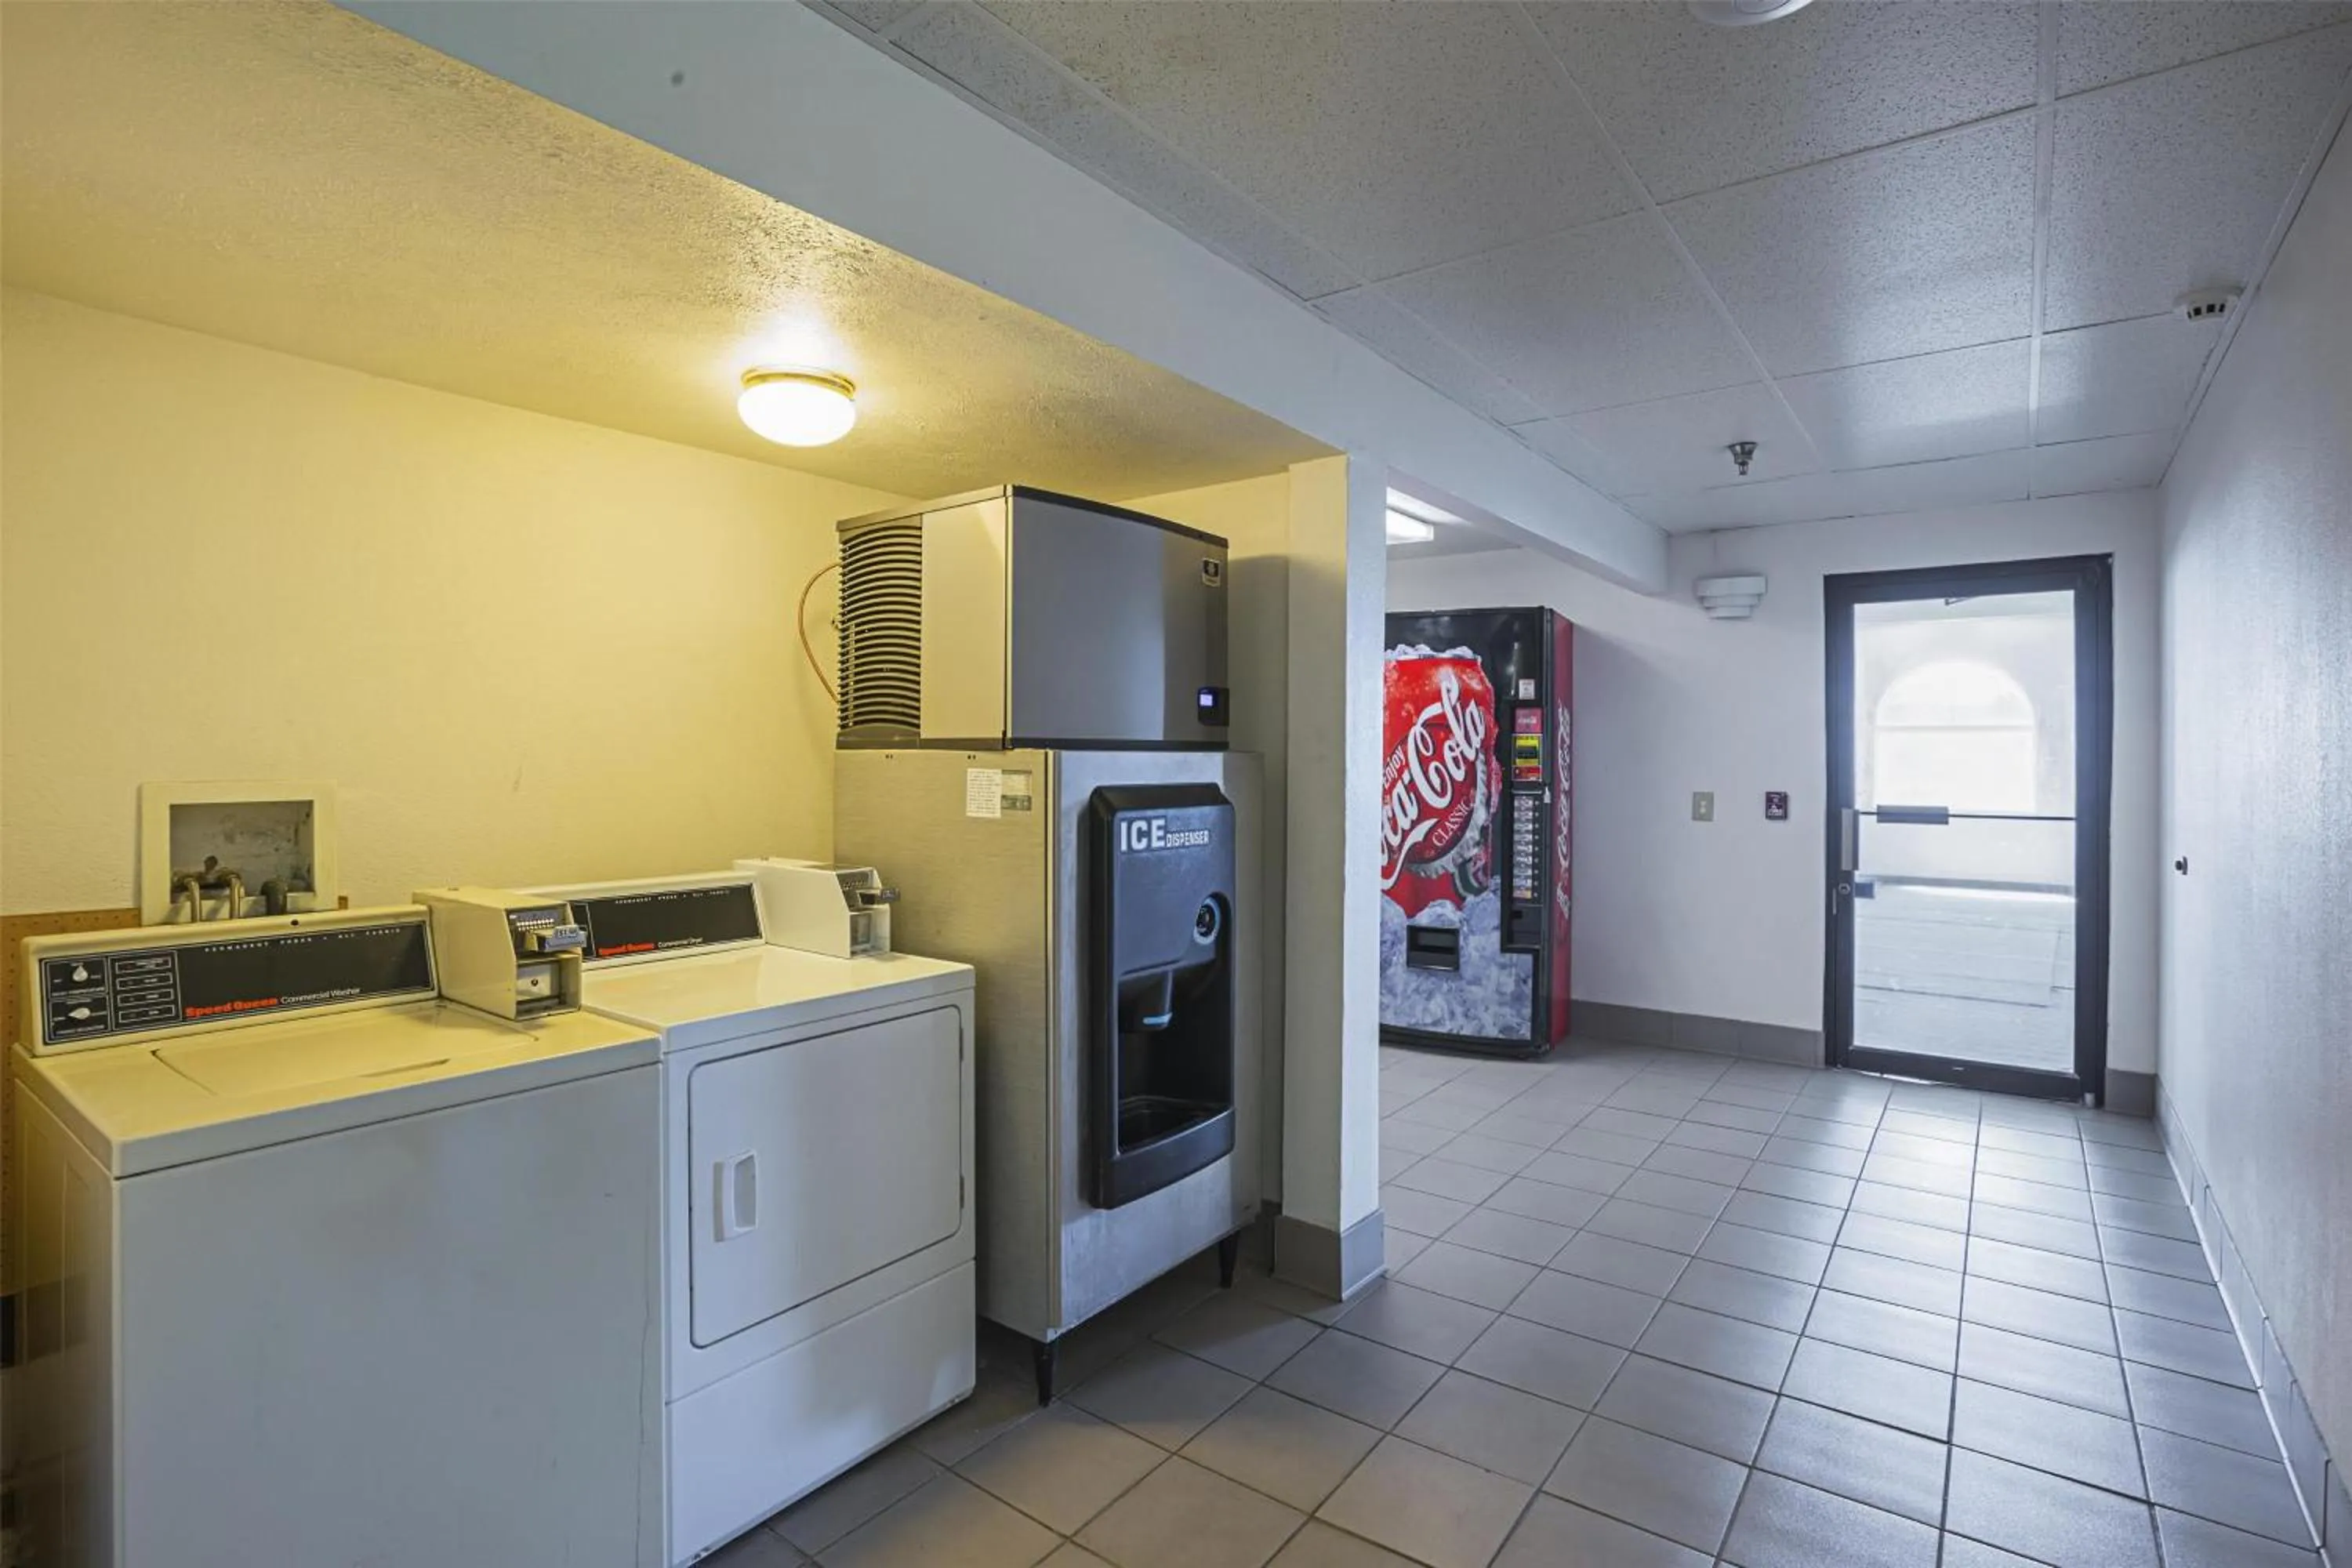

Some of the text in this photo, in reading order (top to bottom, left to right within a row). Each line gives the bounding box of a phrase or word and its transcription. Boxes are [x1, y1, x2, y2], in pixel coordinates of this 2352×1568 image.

[1120, 818, 1209, 852] ICE DISPENSER
[1432, 795, 1473, 847] CLASSIC
[185, 1002, 232, 1018] Speed
[233, 996, 278, 1011] Queen
[280, 991, 330, 1004] Commercial
